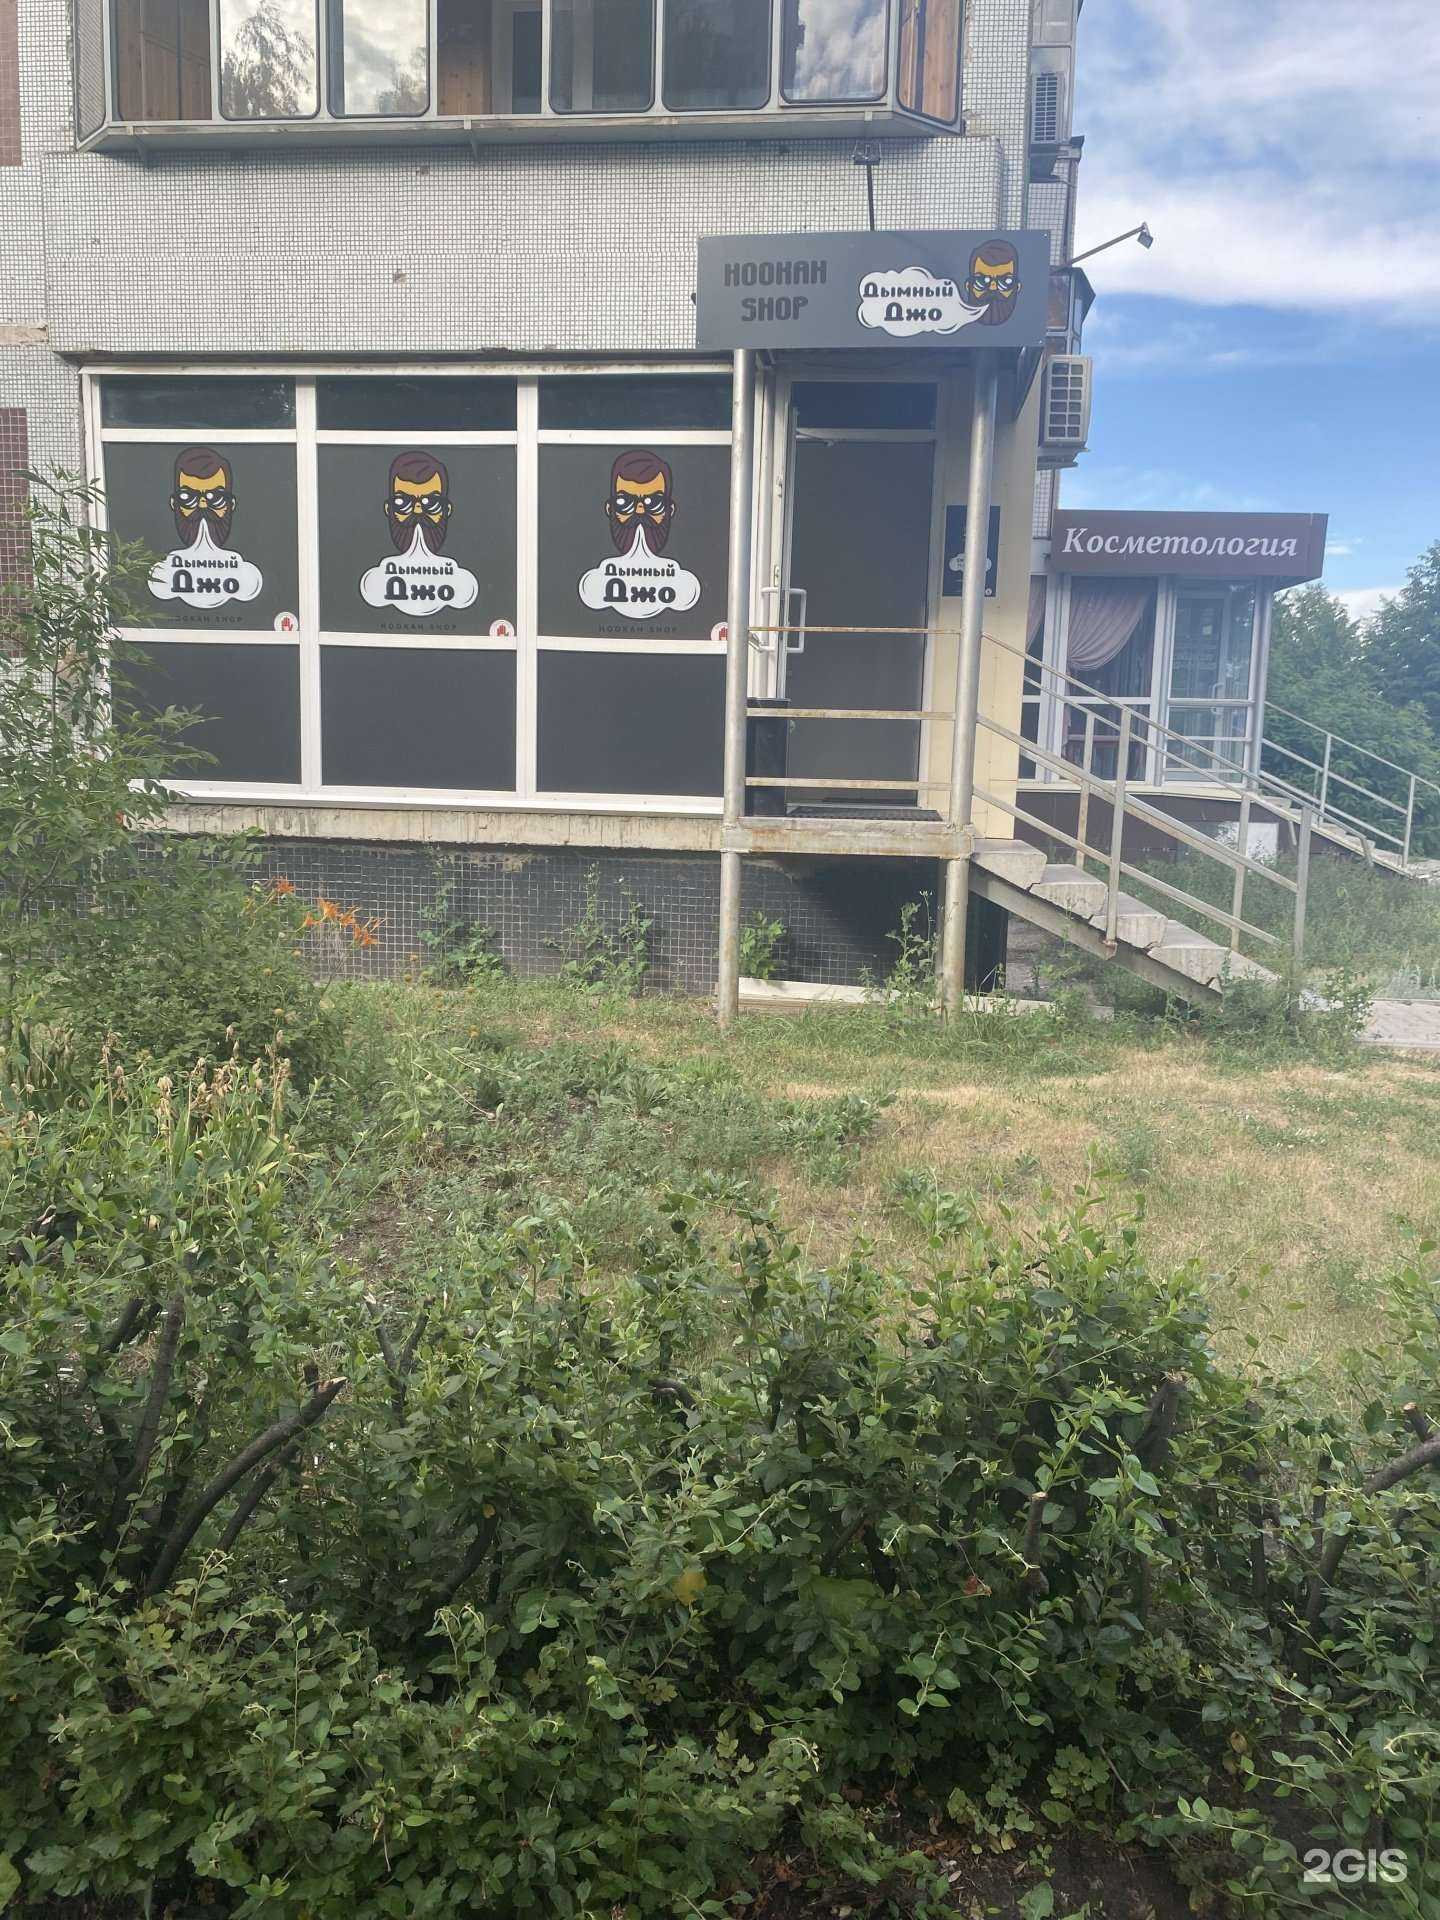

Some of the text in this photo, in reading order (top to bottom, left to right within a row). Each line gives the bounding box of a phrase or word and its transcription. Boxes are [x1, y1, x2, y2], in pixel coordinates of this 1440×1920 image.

[724, 260, 827, 286] HOOKAH
[862, 281, 953, 298] Дымный
[741, 296, 809, 322] SHOP
[884, 302, 943, 322] Джо
[1062, 527, 1298, 557] Косметология
[171, 555, 239, 569] Дымный
[385, 561, 454, 575] Дымный
[605, 563, 676, 577] Дымный
[171, 569, 240, 594] Джо
[384, 576, 455, 601] Джо
[603, 578, 676, 603] Джо
[599, 625, 644, 633] HOOKAH
